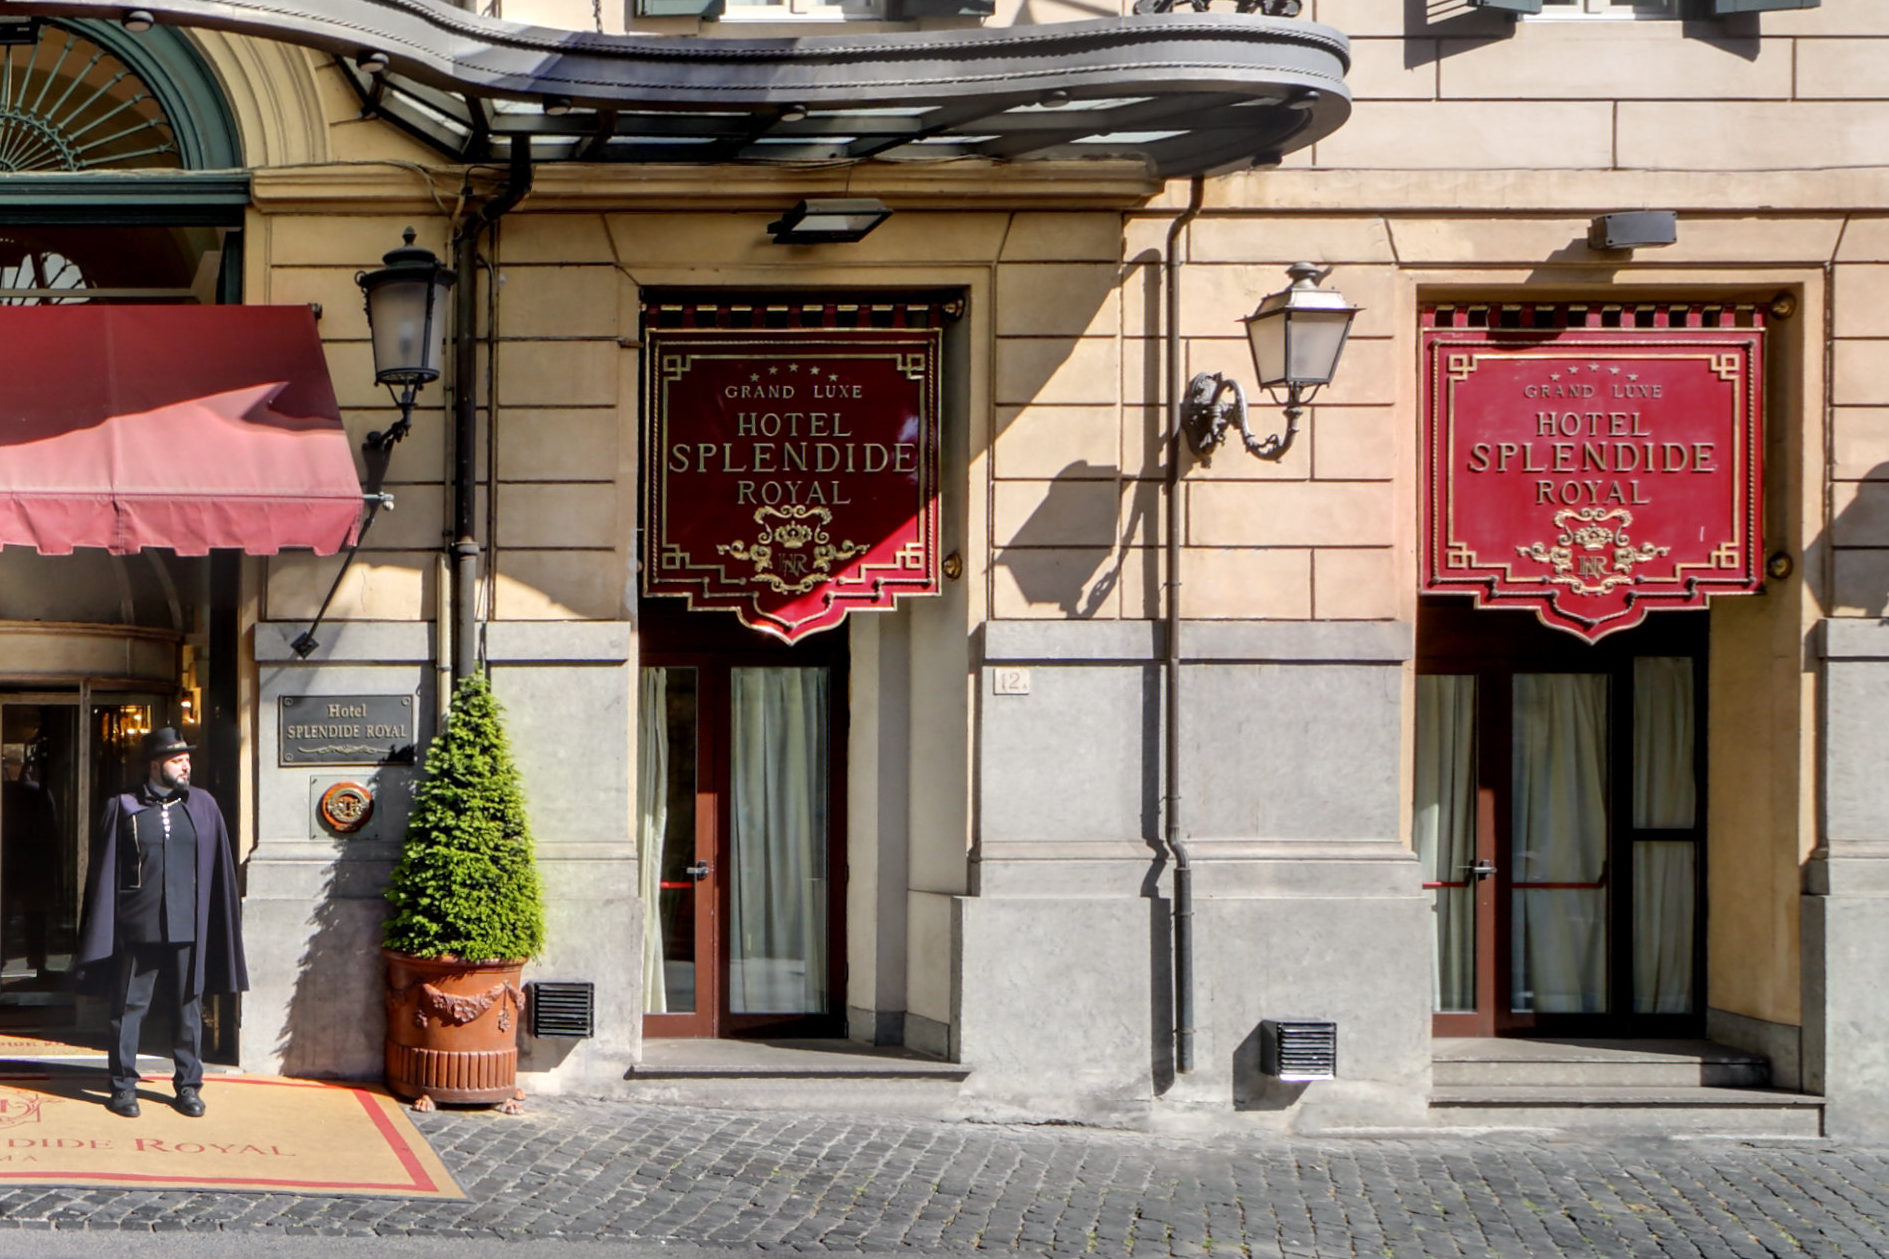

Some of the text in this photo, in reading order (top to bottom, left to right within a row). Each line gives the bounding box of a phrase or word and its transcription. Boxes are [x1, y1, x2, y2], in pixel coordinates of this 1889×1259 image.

[725, 385, 863, 399] GRAND LUXE
[1523, 385, 1663, 399] GRAND LUXE
[737, 412, 853, 437] HOTEL
[1535, 411, 1652, 437] HOTEL
[668, 442, 919, 473] SPLENDIDE
[1468, 441, 1719, 473] SPLENDIDE
[736, 480, 852, 505] ROYAL
[1535, 480, 1651, 505] ROYAL
[327, 703, 367, 719] Hotel
[286, 724, 408, 740] SPLENDIDE ROYAL
[135, 1137, 297, 1157] ROYAL
